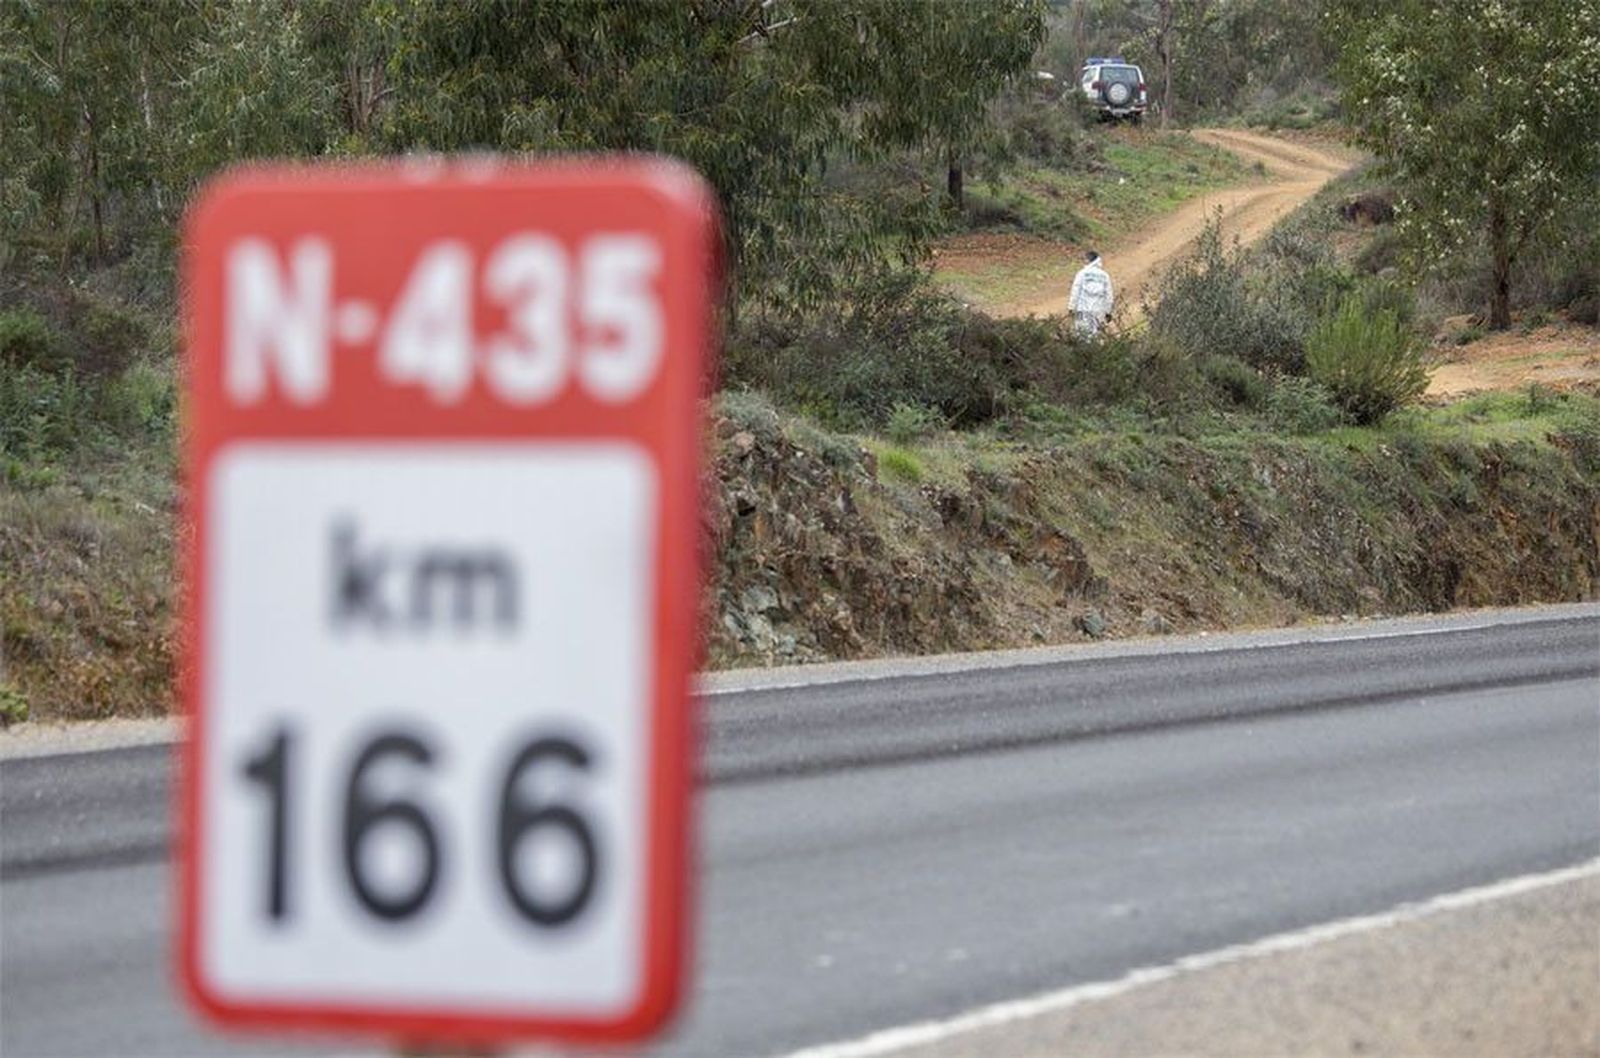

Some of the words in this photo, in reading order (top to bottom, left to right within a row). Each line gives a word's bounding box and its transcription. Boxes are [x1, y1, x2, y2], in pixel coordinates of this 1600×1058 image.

[224, 233, 666, 403] N-435
[327, 518, 519, 634] km
[237, 720, 604, 930] 166
